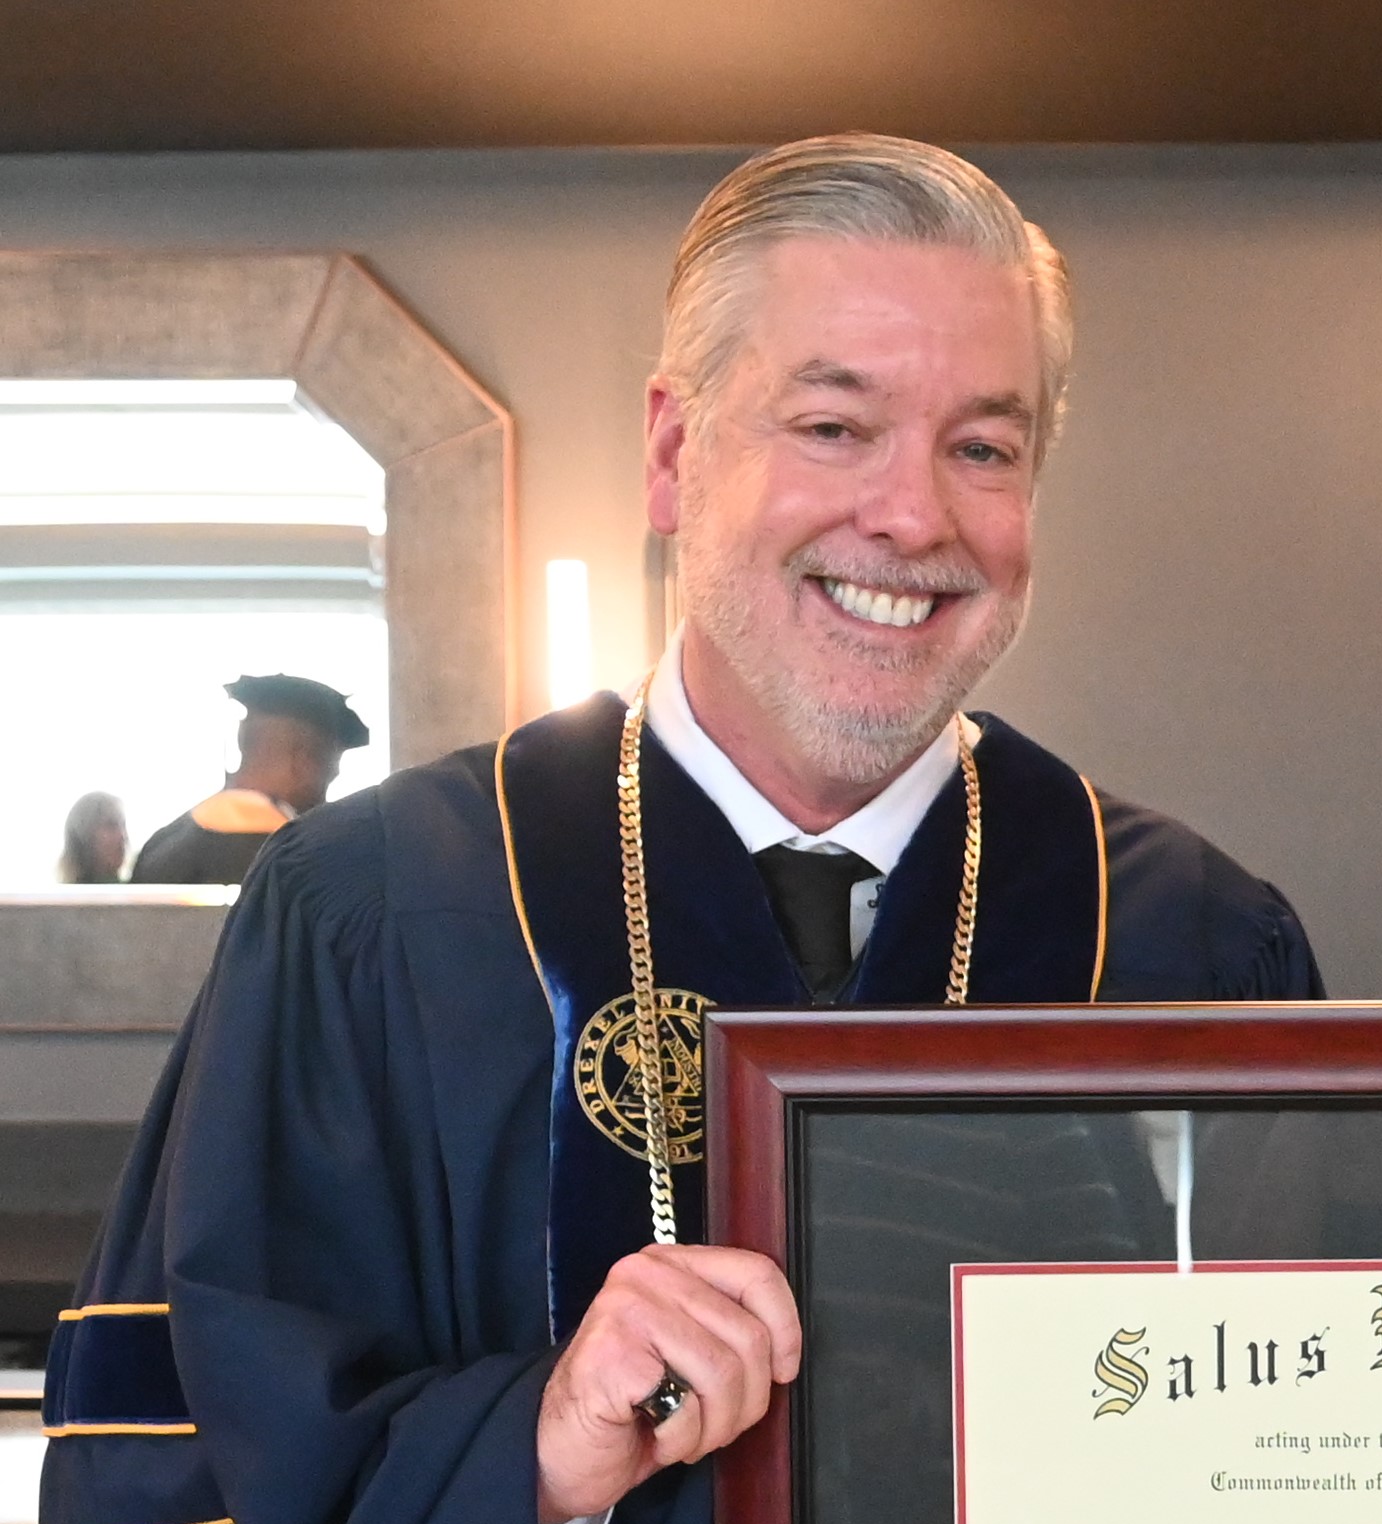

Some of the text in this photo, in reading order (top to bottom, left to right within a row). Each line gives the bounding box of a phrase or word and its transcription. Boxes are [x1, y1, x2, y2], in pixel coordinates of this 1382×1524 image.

[1091, 1319, 1331, 1421] Salus
[1254, 1431, 1312, 1455] acting
[1318, 1431, 1371, 1449] under
[1210, 1470, 1357, 1492] Commonwealth
